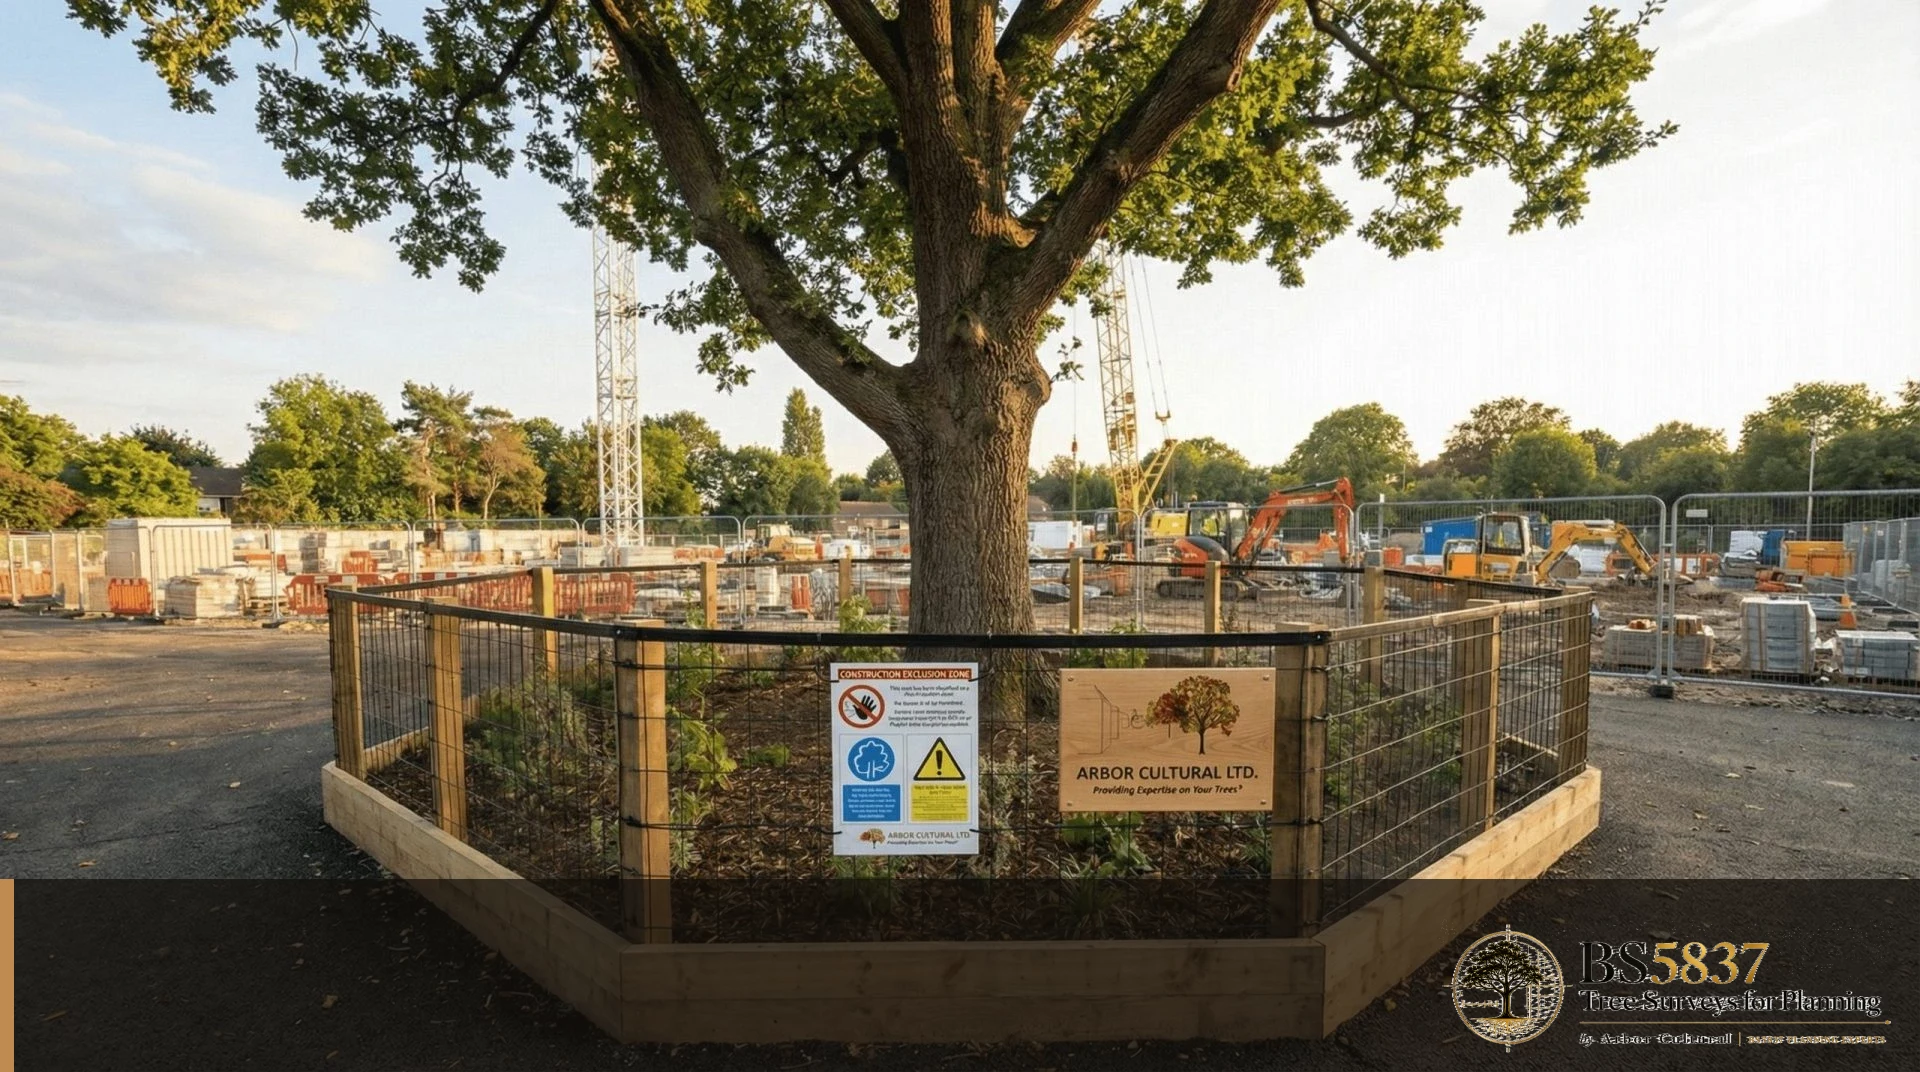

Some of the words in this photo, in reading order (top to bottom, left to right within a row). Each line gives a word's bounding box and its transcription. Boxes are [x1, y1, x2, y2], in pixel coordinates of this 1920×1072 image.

[839, 669, 901, 679] CONSTRUCTION
[902, 669, 946, 679] EXCLUSION
[1076, 766, 1134, 780] ARBOR
[1139, 766, 1222, 780] CULTURAL
[1226, 765, 1259, 780] LTD.
[1092, 785, 1135, 796] Providing
[1136, 785, 1178, 796] Expertise
[1193, 785, 1213, 794] Your
[888, 831, 915, 839] ARBOR
[916, 831, 954, 839] CULTURAL
